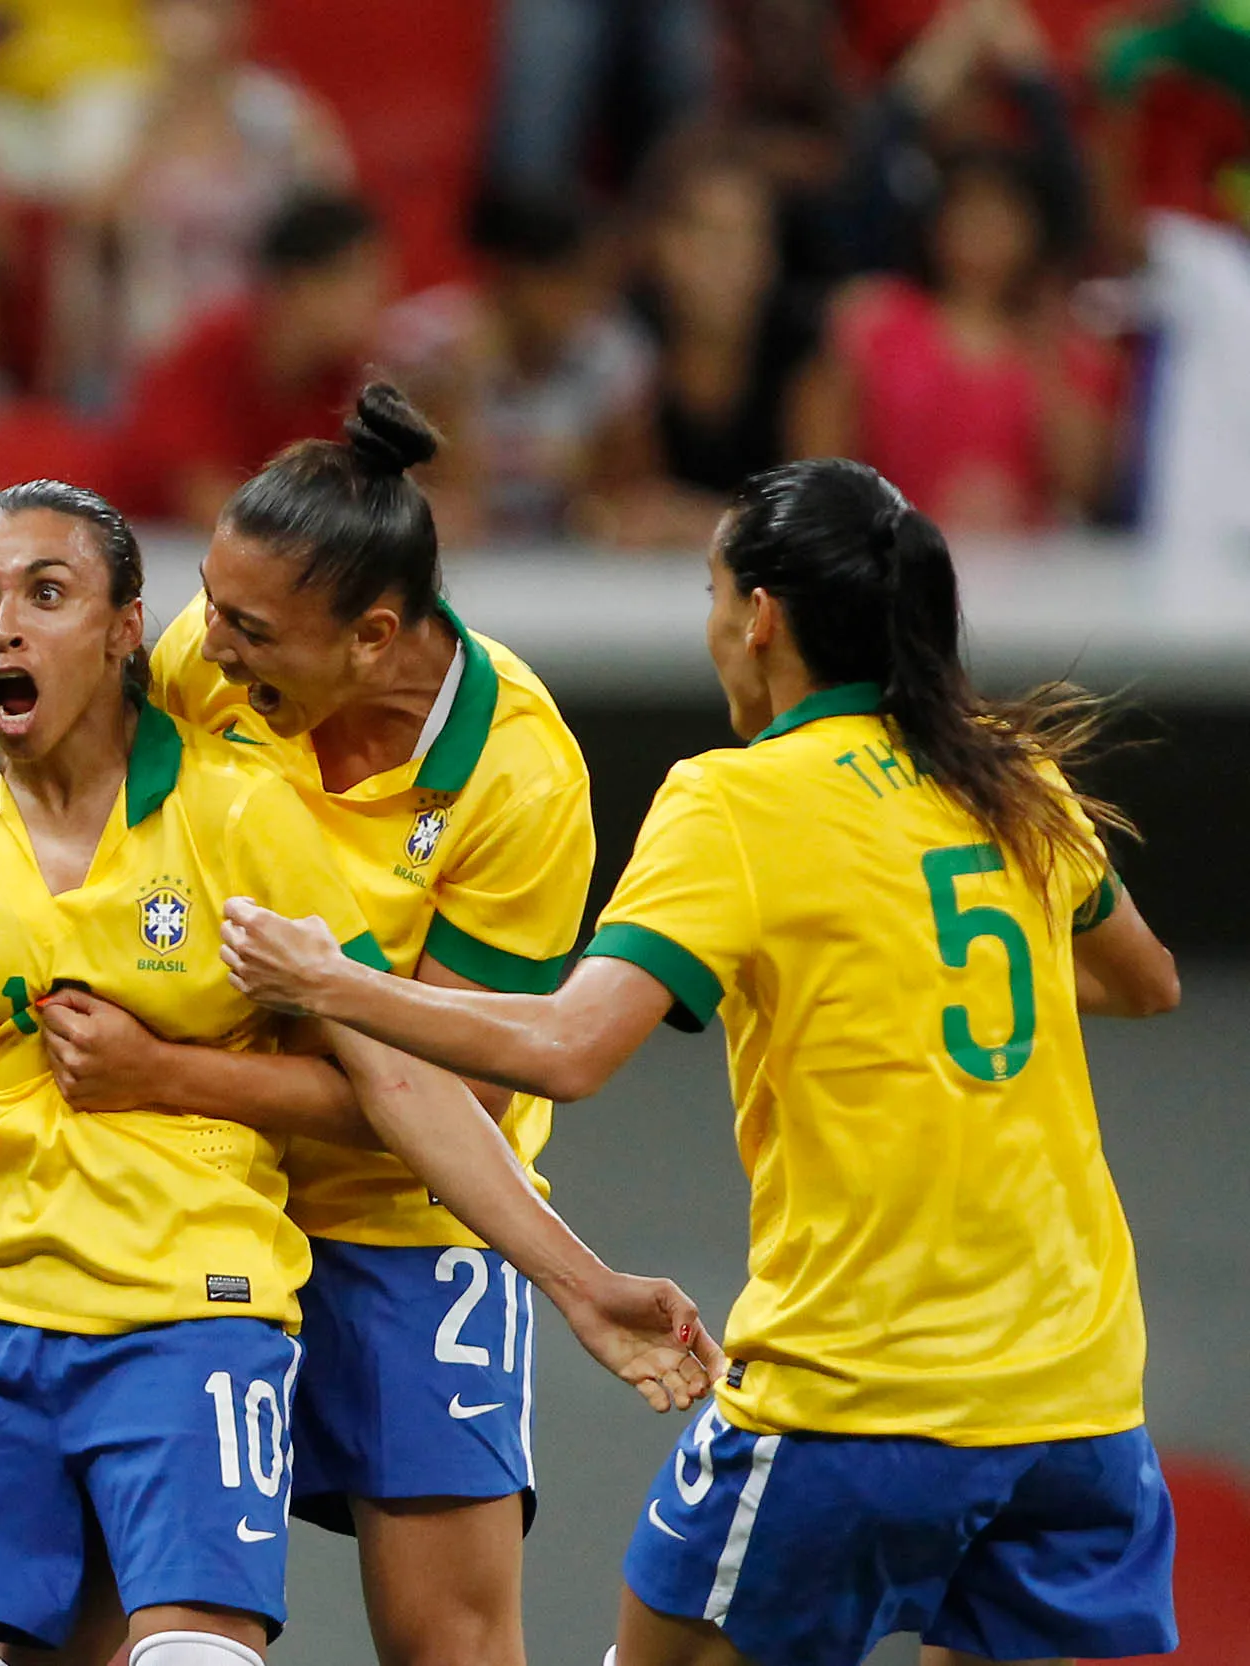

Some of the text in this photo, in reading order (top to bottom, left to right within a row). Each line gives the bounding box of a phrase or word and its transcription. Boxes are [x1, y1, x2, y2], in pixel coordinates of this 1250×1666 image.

[393, 864, 427, 889] BRASIL
[137, 959, 187, 973] BRASIL
[921, 843, 1035, 1082] 5
[434, 1246, 519, 1373] 21
[205, 1371, 283, 1498] 10
